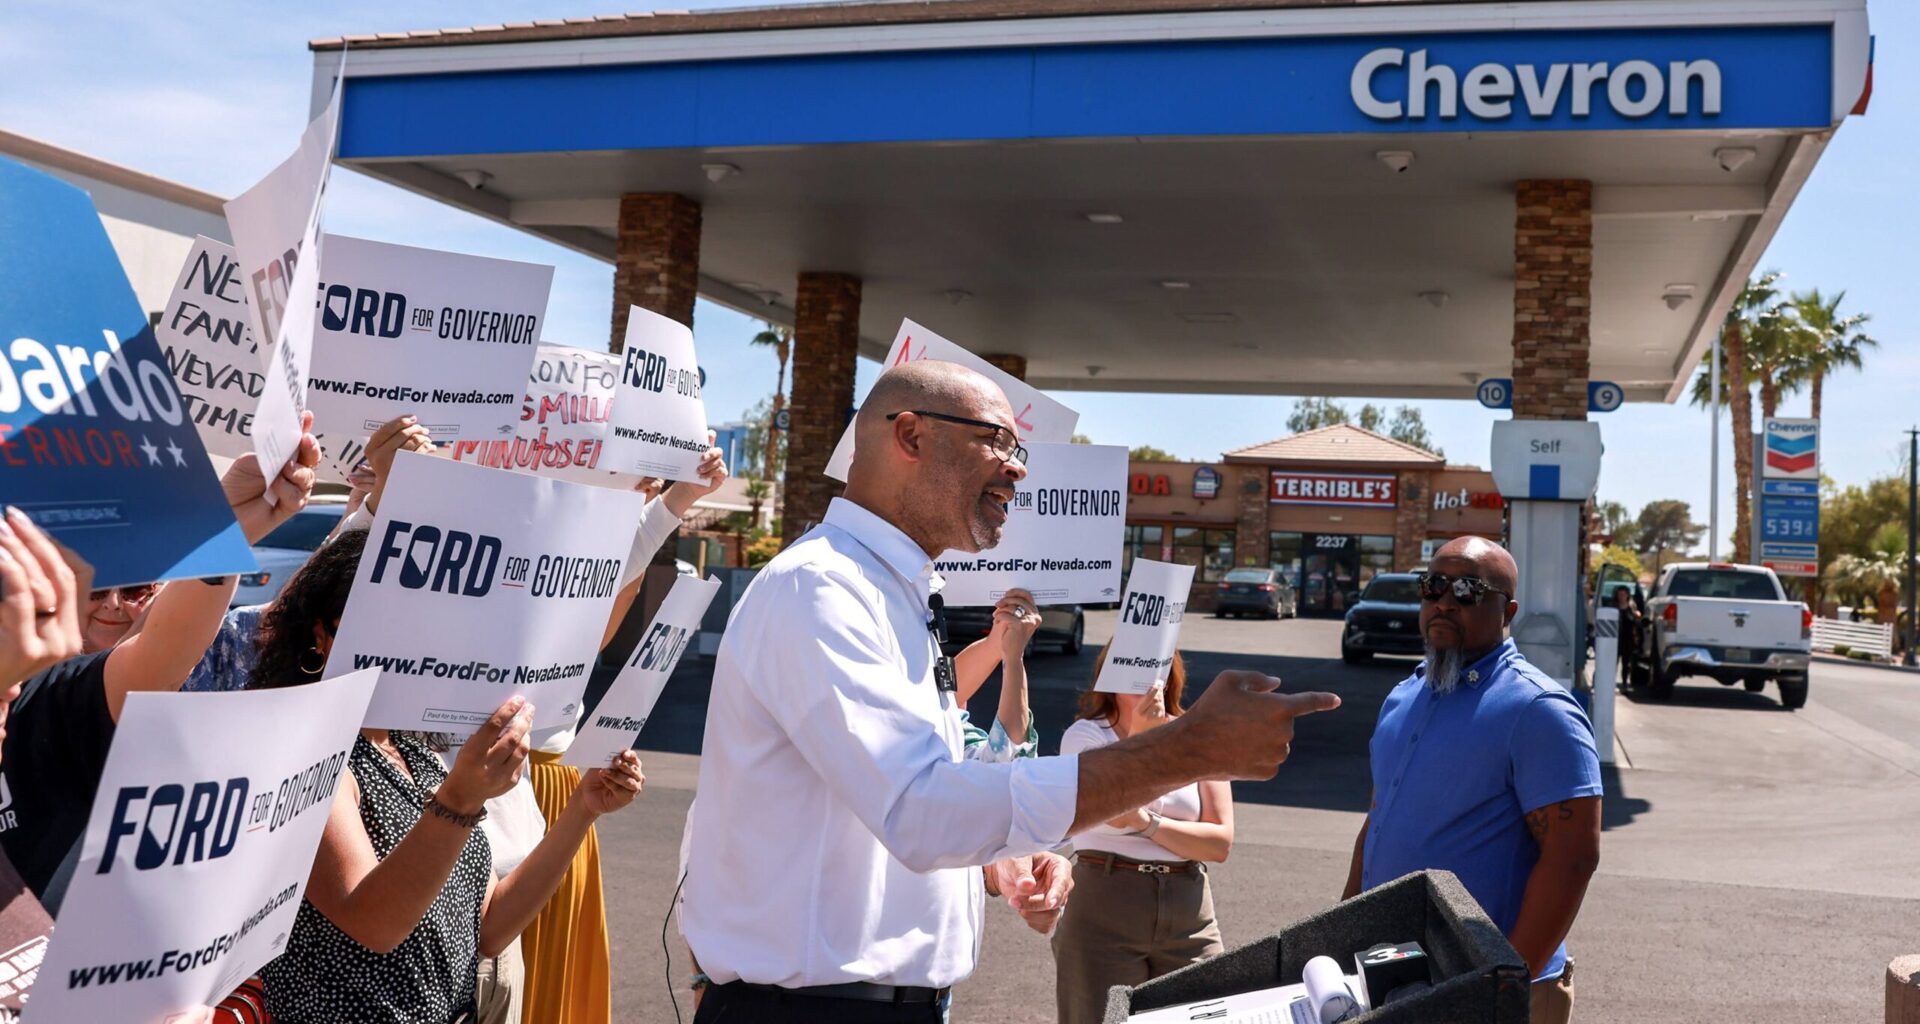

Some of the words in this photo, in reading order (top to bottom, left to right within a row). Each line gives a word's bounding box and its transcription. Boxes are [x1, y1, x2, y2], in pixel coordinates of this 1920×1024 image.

[1350, 47, 1722, 120] Chevron
[184, 250, 248, 305] NE
[411, 308, 434, 327] FOR
[438, 307, 537, 345] GOVERNOR
[530, 360, 578, 384] ON
[622, 346, 667, 393] FORD
[307, 378, 429, 403] ww.FordFor
[431, 389, 514, 404] Nevada.com
[1482, 386, 1503, 401] 10
[1601, 389, 1613, 404] 9
[614, 426, 669, 445] www.FordFor
[1767, 421, 1817, 433] Chevron
[1530, 440, 1561, 453] Self
[1275, 478, 1392, 499] TERRIBLE'S
[1433, 488, 1469, 511] Hot
[1014, 491, 1033, 507] FOR
[1037, 488, 1120, 517] GOVERNOR
[1315, 535, 1348, 548] 2237
[370, 519, 502, 598] FORD
[503, 556, 530, 582] FOR
[531, 554, 621, 599] GOVERNOR
[933, 559, 1038, 571] www.FordFor
[1040, 558, 1112, 571] Nevada.com
[1122, 591, 1165, 627] FORD
[631, 622, 687, 673] FORD
[353, 653, 510, 684] www.FordFor
[513, 662, 584, 685] Nevada.com
[94, 777, 250, 875] FORD
[248, 790, 274, 826] FOR
[269, 750, 346, 833] GOVERNOR
[67, 930, 238, 990] www.FordFor
[236, 881, 299, 942] Nevada.com
[1364, 947, 1398, 964] 3
